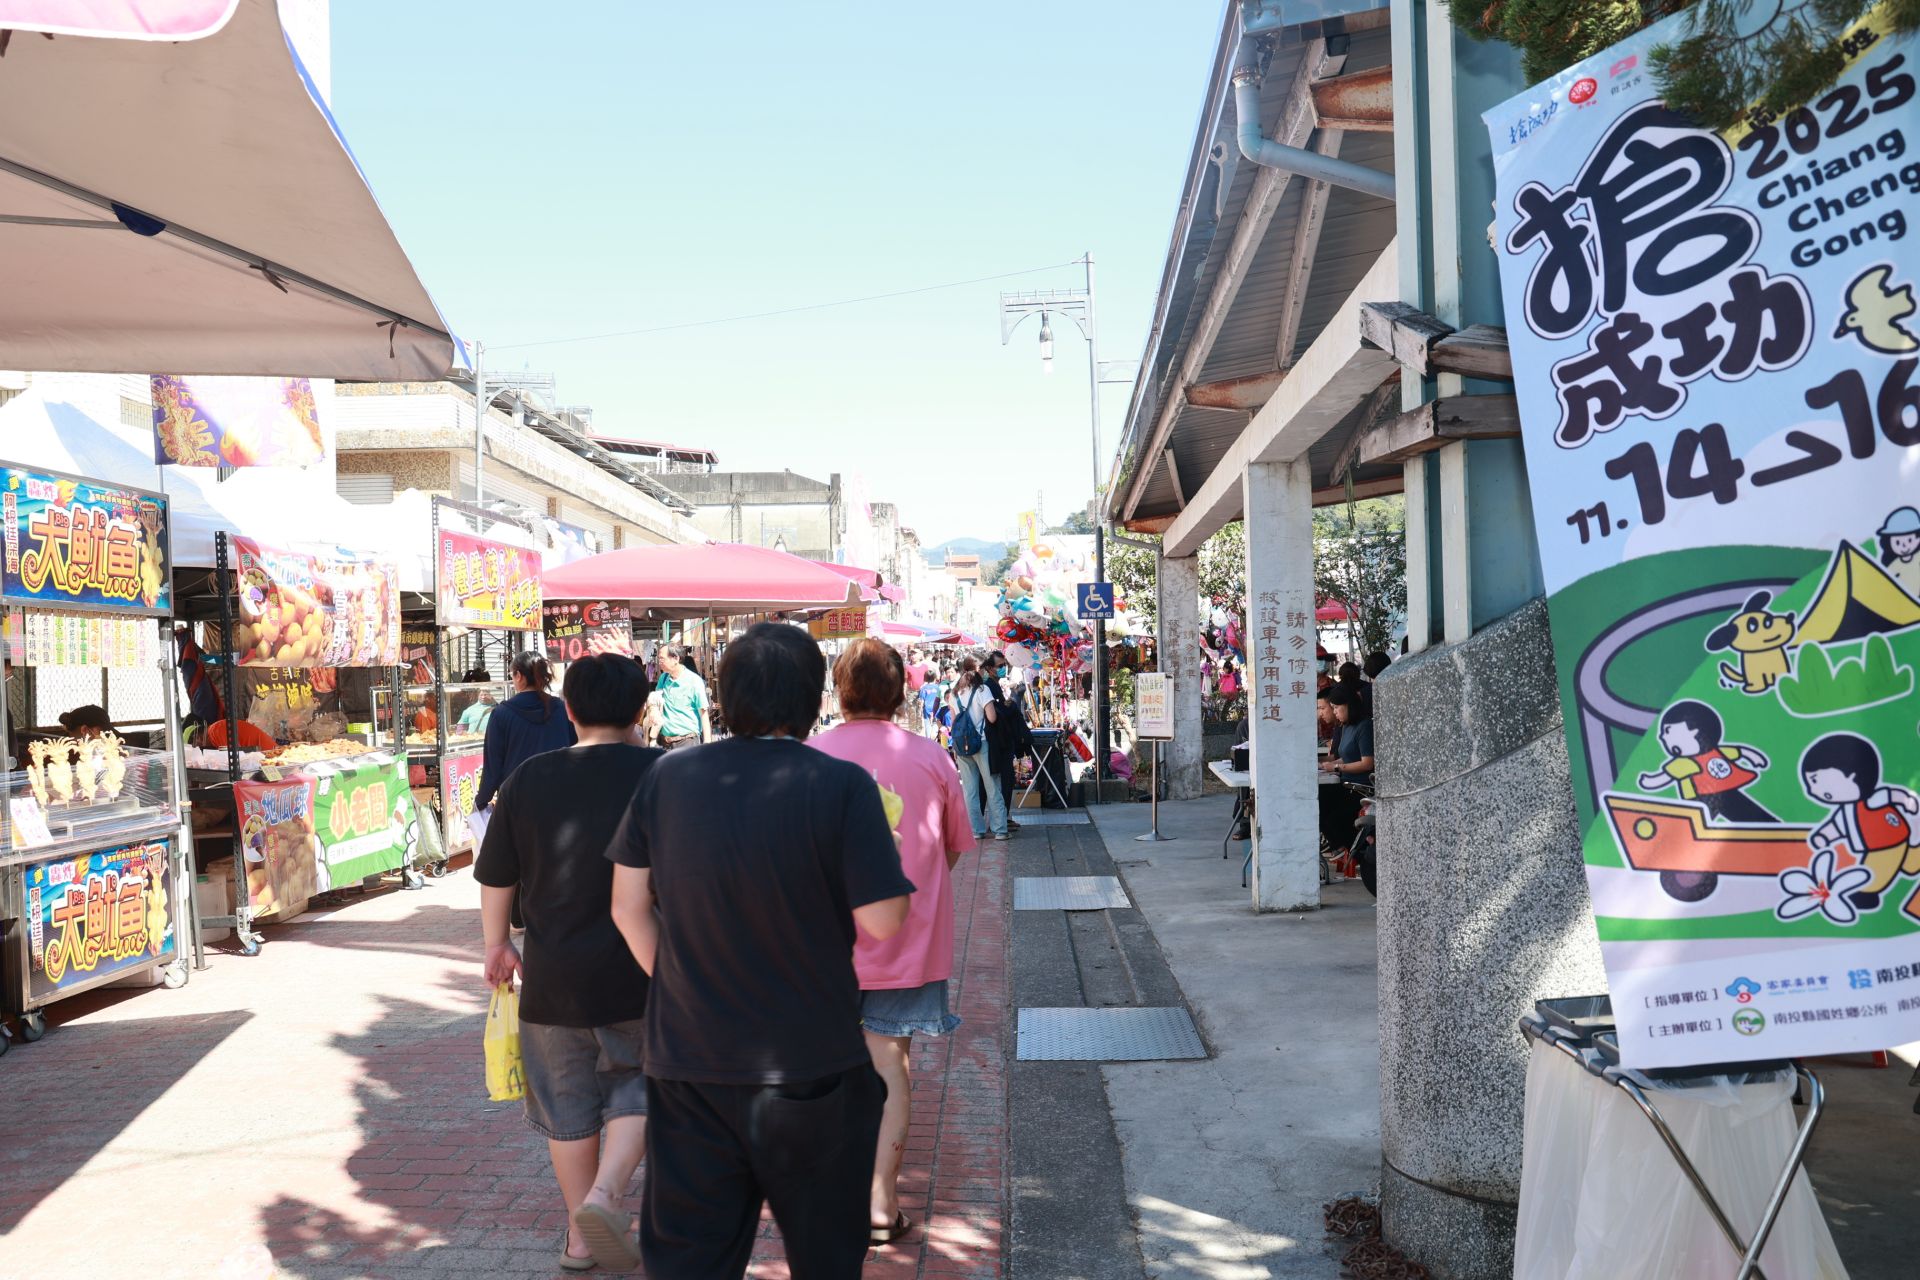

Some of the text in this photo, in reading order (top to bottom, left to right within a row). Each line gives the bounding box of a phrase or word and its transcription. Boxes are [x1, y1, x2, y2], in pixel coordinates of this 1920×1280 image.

[1737, 53, 1916, 180] 2025
[1757, 128, 1906, 210] Chiang
[1787, 162, 1920, 233] Cheng
[1511, 101, 1756, 335] 搶
[1790, 209, 1907, 268] Gong
[1555, 270, 1807, 444] 成功
[23, 504, 140, 597] 大魷魚
[828, 611, 865, 631] 杏鮑菇
[1259, 591, 1283, 722] 救護車專用車道
[1286, 612, 1309, 699] 請勿停車
[262, 783, 310, 825] 地瓜球
[329, 782, 388, 841] 小老闆
[46, 875, 147, 978] 大魷魚
[1773, 1002, 1887, 1025] 南投縣國姓鄉公所
